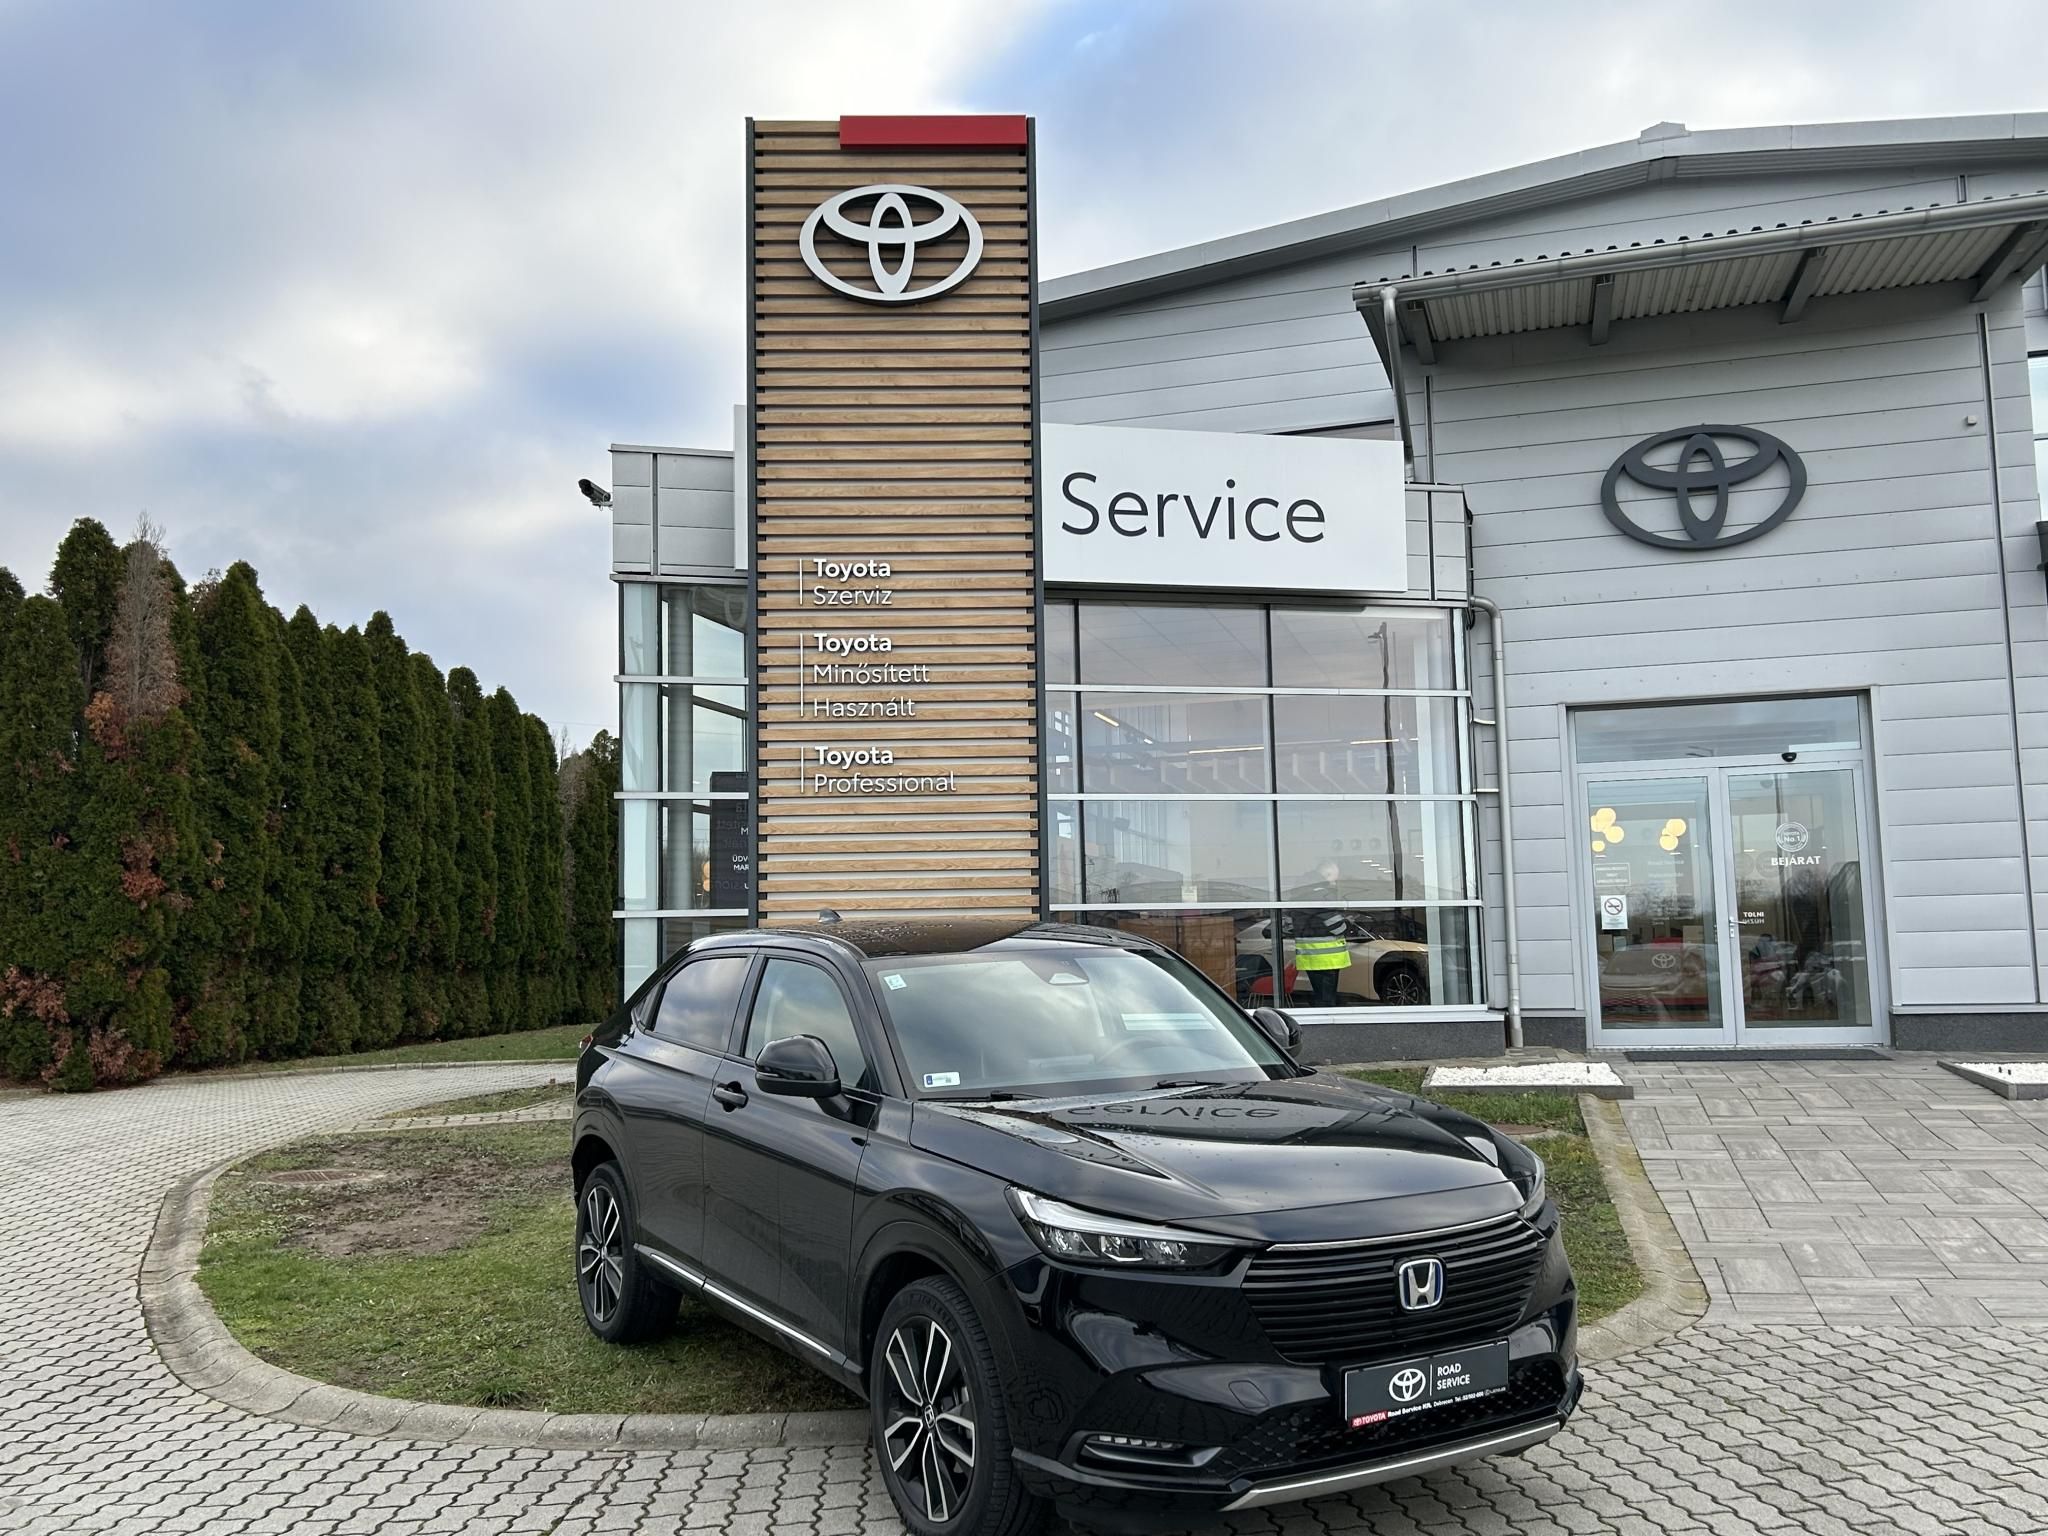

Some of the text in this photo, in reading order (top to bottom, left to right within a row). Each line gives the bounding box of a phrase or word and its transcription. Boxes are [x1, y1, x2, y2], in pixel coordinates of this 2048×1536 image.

[1061, 471, 1326, 544] Service
[813, 558, 892, 581] Toyota
[813, 585, 893, 605] Szerviz
[813, 633, 893, 657] Toyota
[813, 663, 930, 685] Minősített
[813, 697, 916, 717] Használt
[814, 746, 894, 770] Toyota
[814, 771, 957, 793] Professional
[1771, 855, 1821, 867] BEJÁRAT
[1437, 1363, 1462, 1377] ROAD
[1436, 1374, 1471, 1391] SERVICE
[1361, 1412, 1387, 1425] TOYOTA
